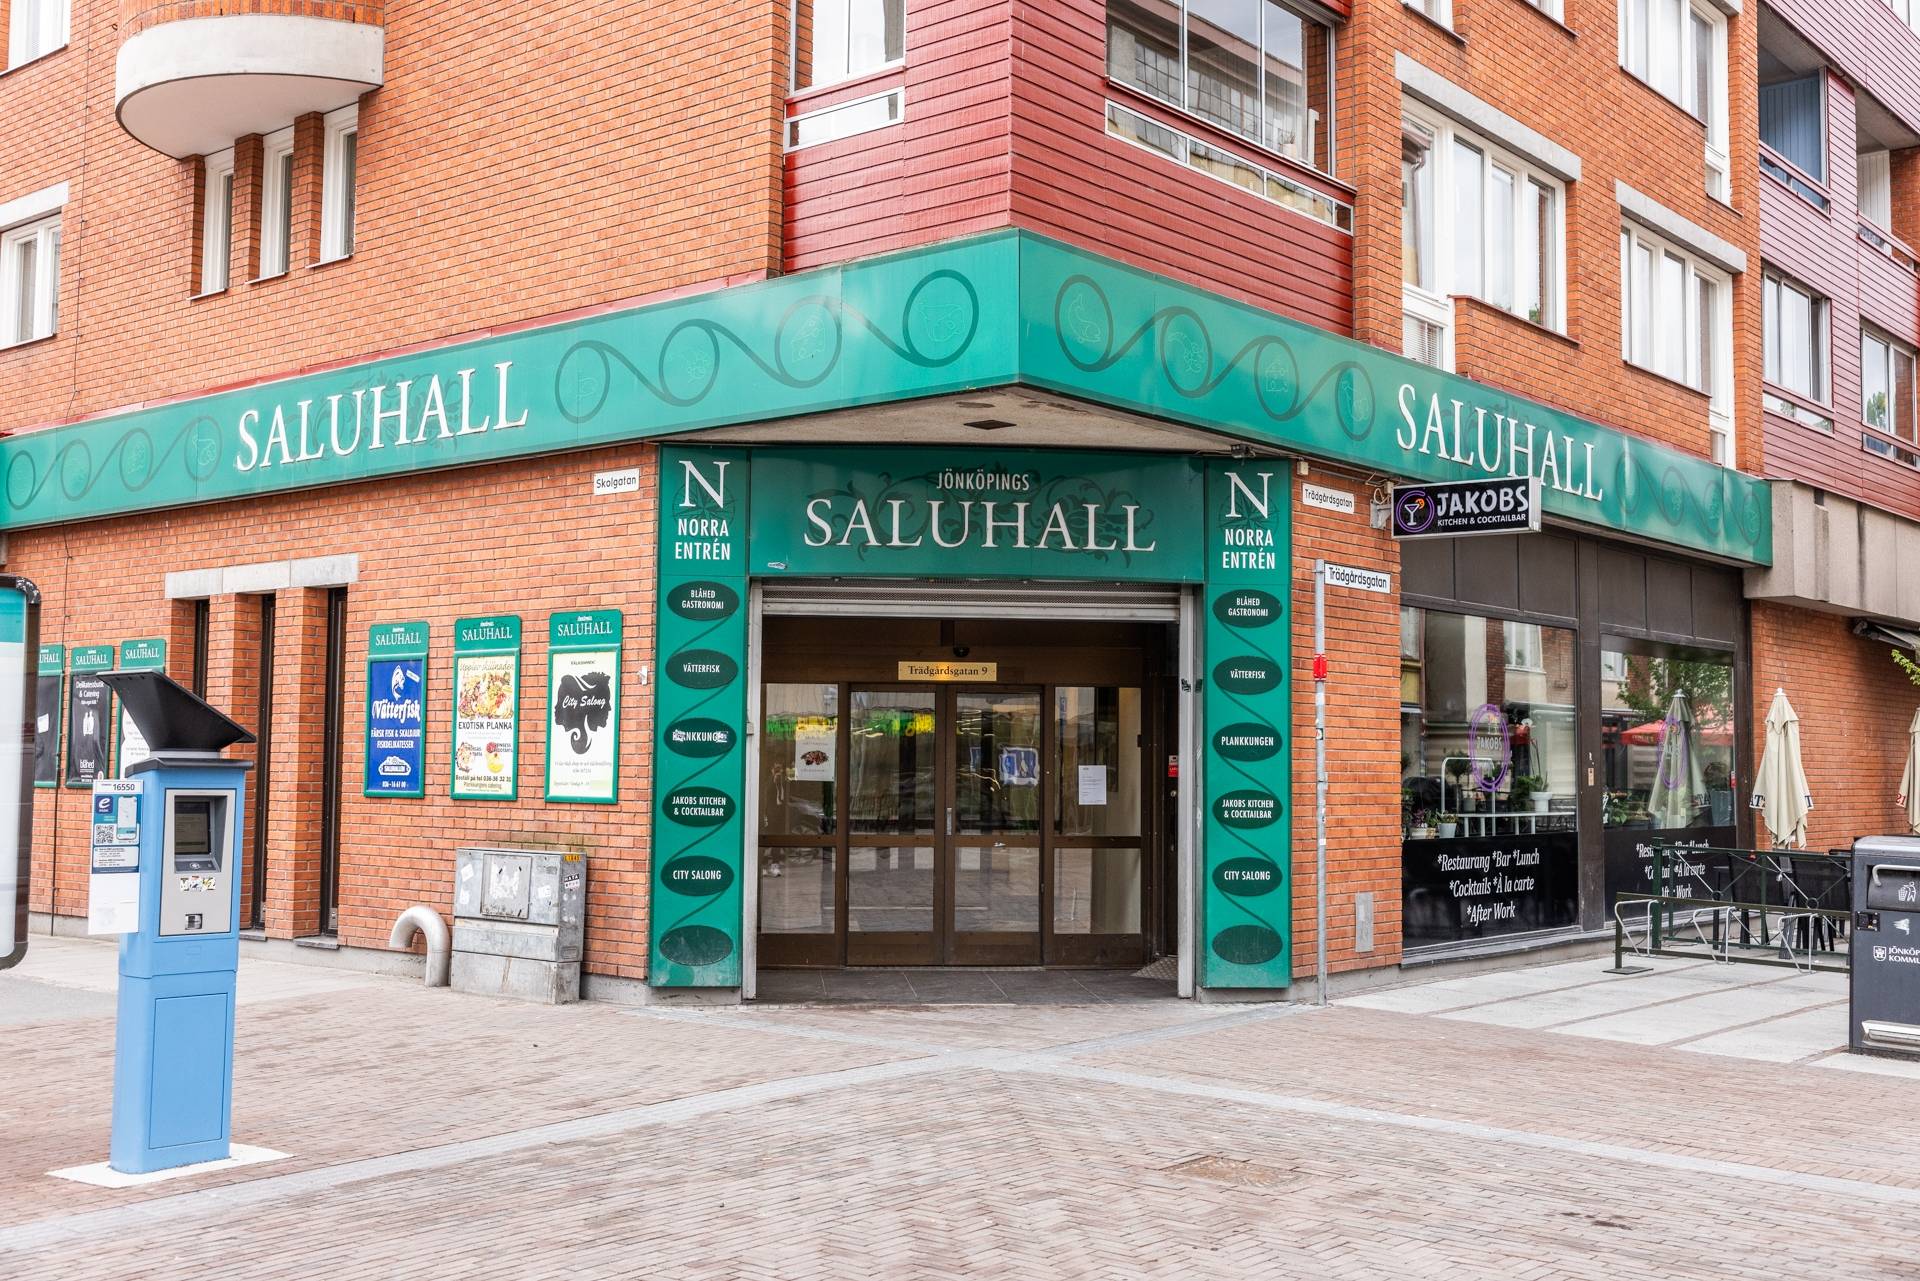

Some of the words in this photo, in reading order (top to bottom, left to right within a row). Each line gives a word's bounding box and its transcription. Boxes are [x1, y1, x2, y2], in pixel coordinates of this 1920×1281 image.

[237, 361, 528, 471] SALUHALL
[1397, 384, 1603, 501] SALUHALL
[596, 476, 637, 489] Skolgatan
[679, 460, 731, 509] N
[937, 468, 1030, 491] JÖNKÖPINGS
[1224, 471, 1274, 519] N
[1305, 488, 1353, 508] Trädgårdsgatan
[1437, 485, 1529, 517] JAKOBS
[804, 498, 1156, 551] SALUHALL
[1437, 517, 1468, 527] KITCHEN
[1477, 513, 1526, 524] COCKTAILBAR
[678, 518, 729, 537] NORRA
[1225, 528, 1274, 547] NORRA
[675, 538, 731, 560] ENTRÉN
[1222, 547, 1276, 570] ENTRÉN
[1328, 566, 1387, 589] Trädgårdsgatan
[690, 587, 716, 598] BLÅHED
[682, 600, 724, 609] GASTRONOMI
[1236, 595, 1260, 606] BLÅHED
[1228, 608, 1268, 617] GASTRONOMI
[462, 627, 512, 641] SALUHALL
[558, 621, 613, 637] SALUHALL
[375, 632, 421, 646] SALUHALL
[76, 655, 108, 665] SALUHALL
[125, 648, 159, 659] SALUHALL
[683, 662, 720, 673] VÄTTERFISK
[908, 665, 979, 677] Trädgårdsgatan
[981, 666, 988, 675] 9
[1230, 668, 1266, 680] VÄTTERFISK
[562, 695, 578, 709] City
[580, 695, 606, 709] Salong
[371, 699, 421, 724] Vätterfisk
[458, 721, 485, 730] EXOTISK
[486, 721, 513, 730] PLANKA
[1221, 736, 1274, 746] PLANKKUNGEN
[112, 783, 135, 791] 16550
[672, 796, 697, 805] JAKOBS
[699, 796, 726, 806] KITCHEN
[1222, 799, 1246, 808] JAKOBS
[1247, 799, 1274, 809] KITCHEN
[673, 807, 679, 815] &
[681, 807, 724, 816] COCKTAILBAR
[1224, 810, 1229, 818] &
[1231, 810, 1272, 819] COCKTAILBAR
[673, 870, 690, 880] CITY
[691, 870, 722, 880] SALONG
[1224, 871, 1240, 880] CITY
[1241, 871, 1271, 881] SALONG
[1504, 875, 1512, 892] la
[1514, 876, 1535, 892] carte
[1676, 883, 1692, 898] Work
[1494, 900, 1516, 920] Work
